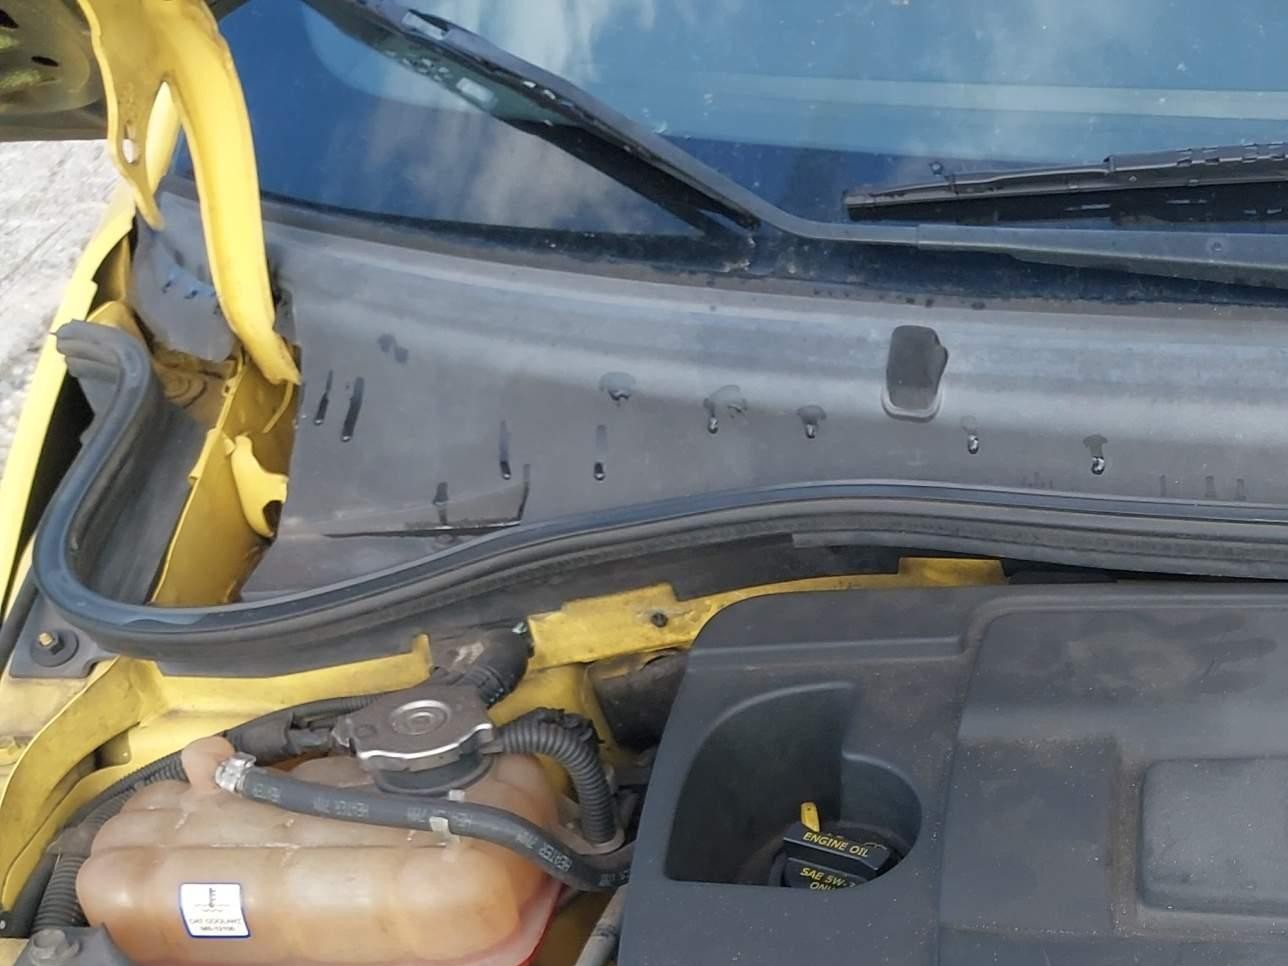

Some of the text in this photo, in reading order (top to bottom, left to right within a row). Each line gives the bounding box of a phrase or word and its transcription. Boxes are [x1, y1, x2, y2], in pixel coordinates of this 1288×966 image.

[538, 842, 572, 873] HEATER
[803, 832, 869, 858] ENGINE OIL
[800, 867, 824, 880] SAE
